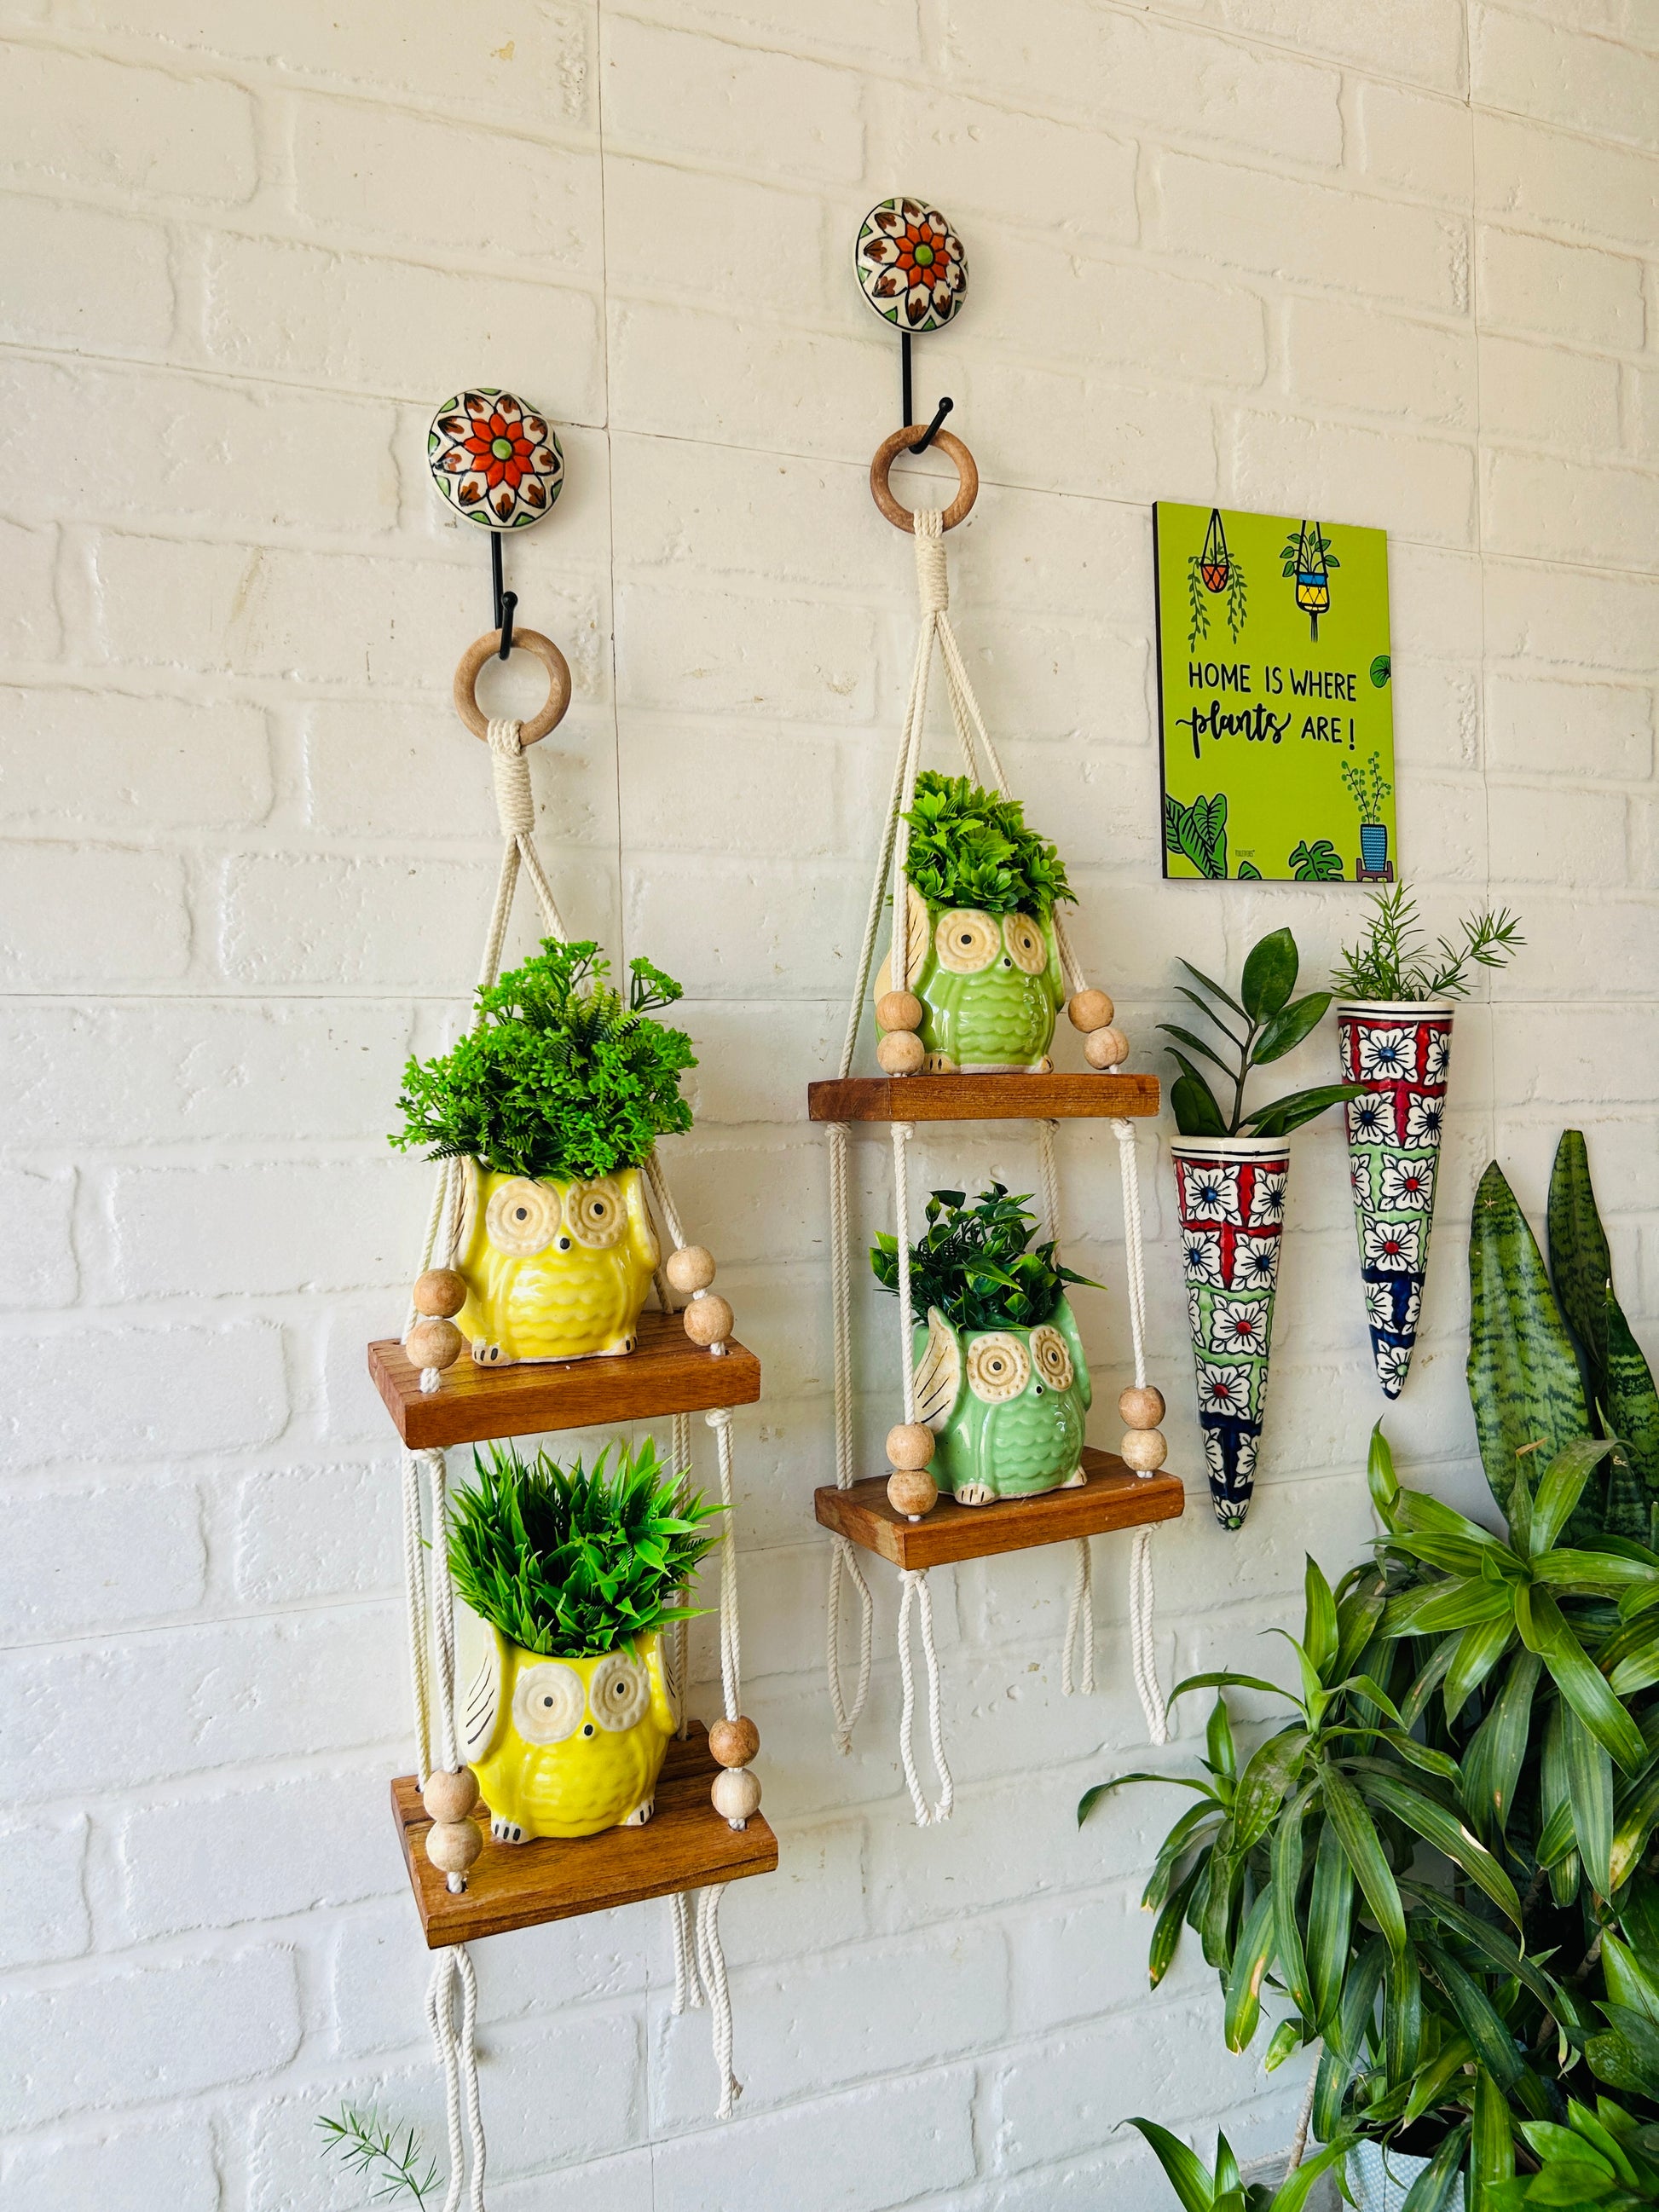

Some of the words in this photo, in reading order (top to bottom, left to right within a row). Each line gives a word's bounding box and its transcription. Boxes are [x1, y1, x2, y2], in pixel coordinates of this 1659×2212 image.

[1188, 661, 1251, 693] HOME
[1265, 665, 1283, 695] IS
[1289, 667, 1357, 702] WHERE
[1175, 700, 1292, 759] plants
